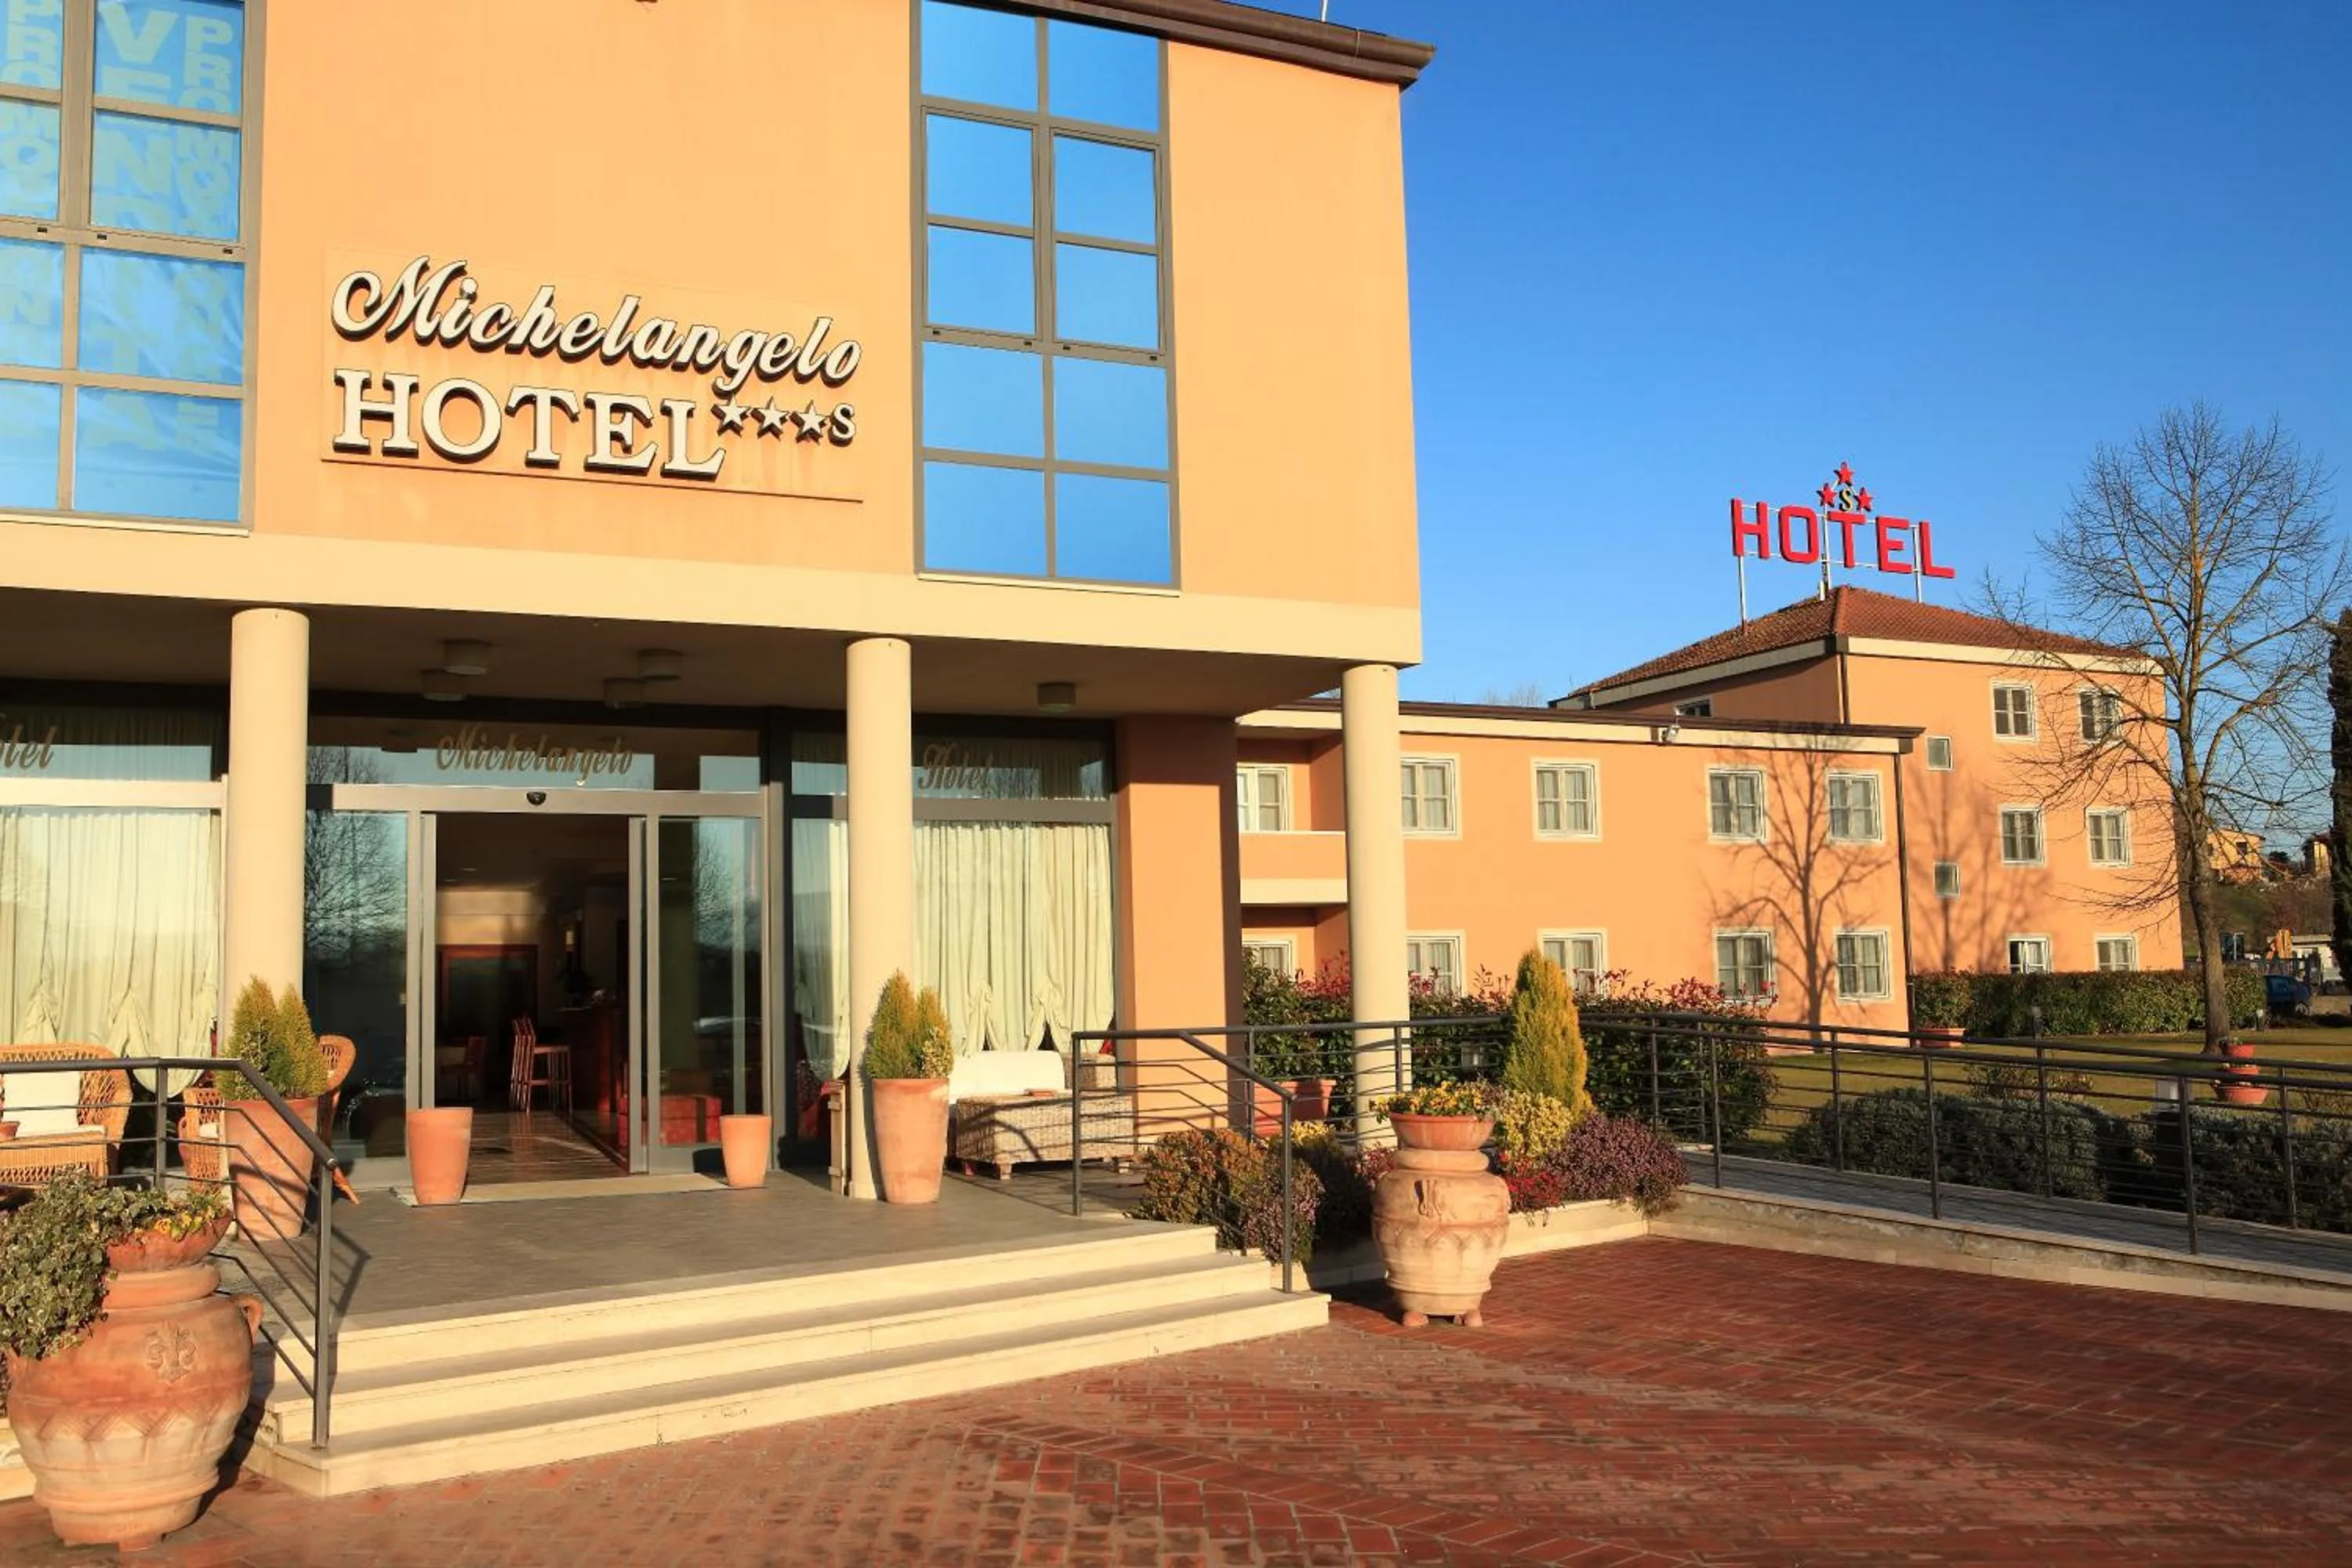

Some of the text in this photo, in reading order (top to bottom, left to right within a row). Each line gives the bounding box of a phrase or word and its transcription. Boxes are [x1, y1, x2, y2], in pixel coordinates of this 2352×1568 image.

[331, 255, 863, 394] Michelangelo
[332, 368, 726, 482] HOTEL
[1730, 497, 1956, 579] HOTEL
[0, 721, 57, 769] tel
[435, 724, 633, 786] Michelangelo
[917, 742, 994, 790] Hotel
